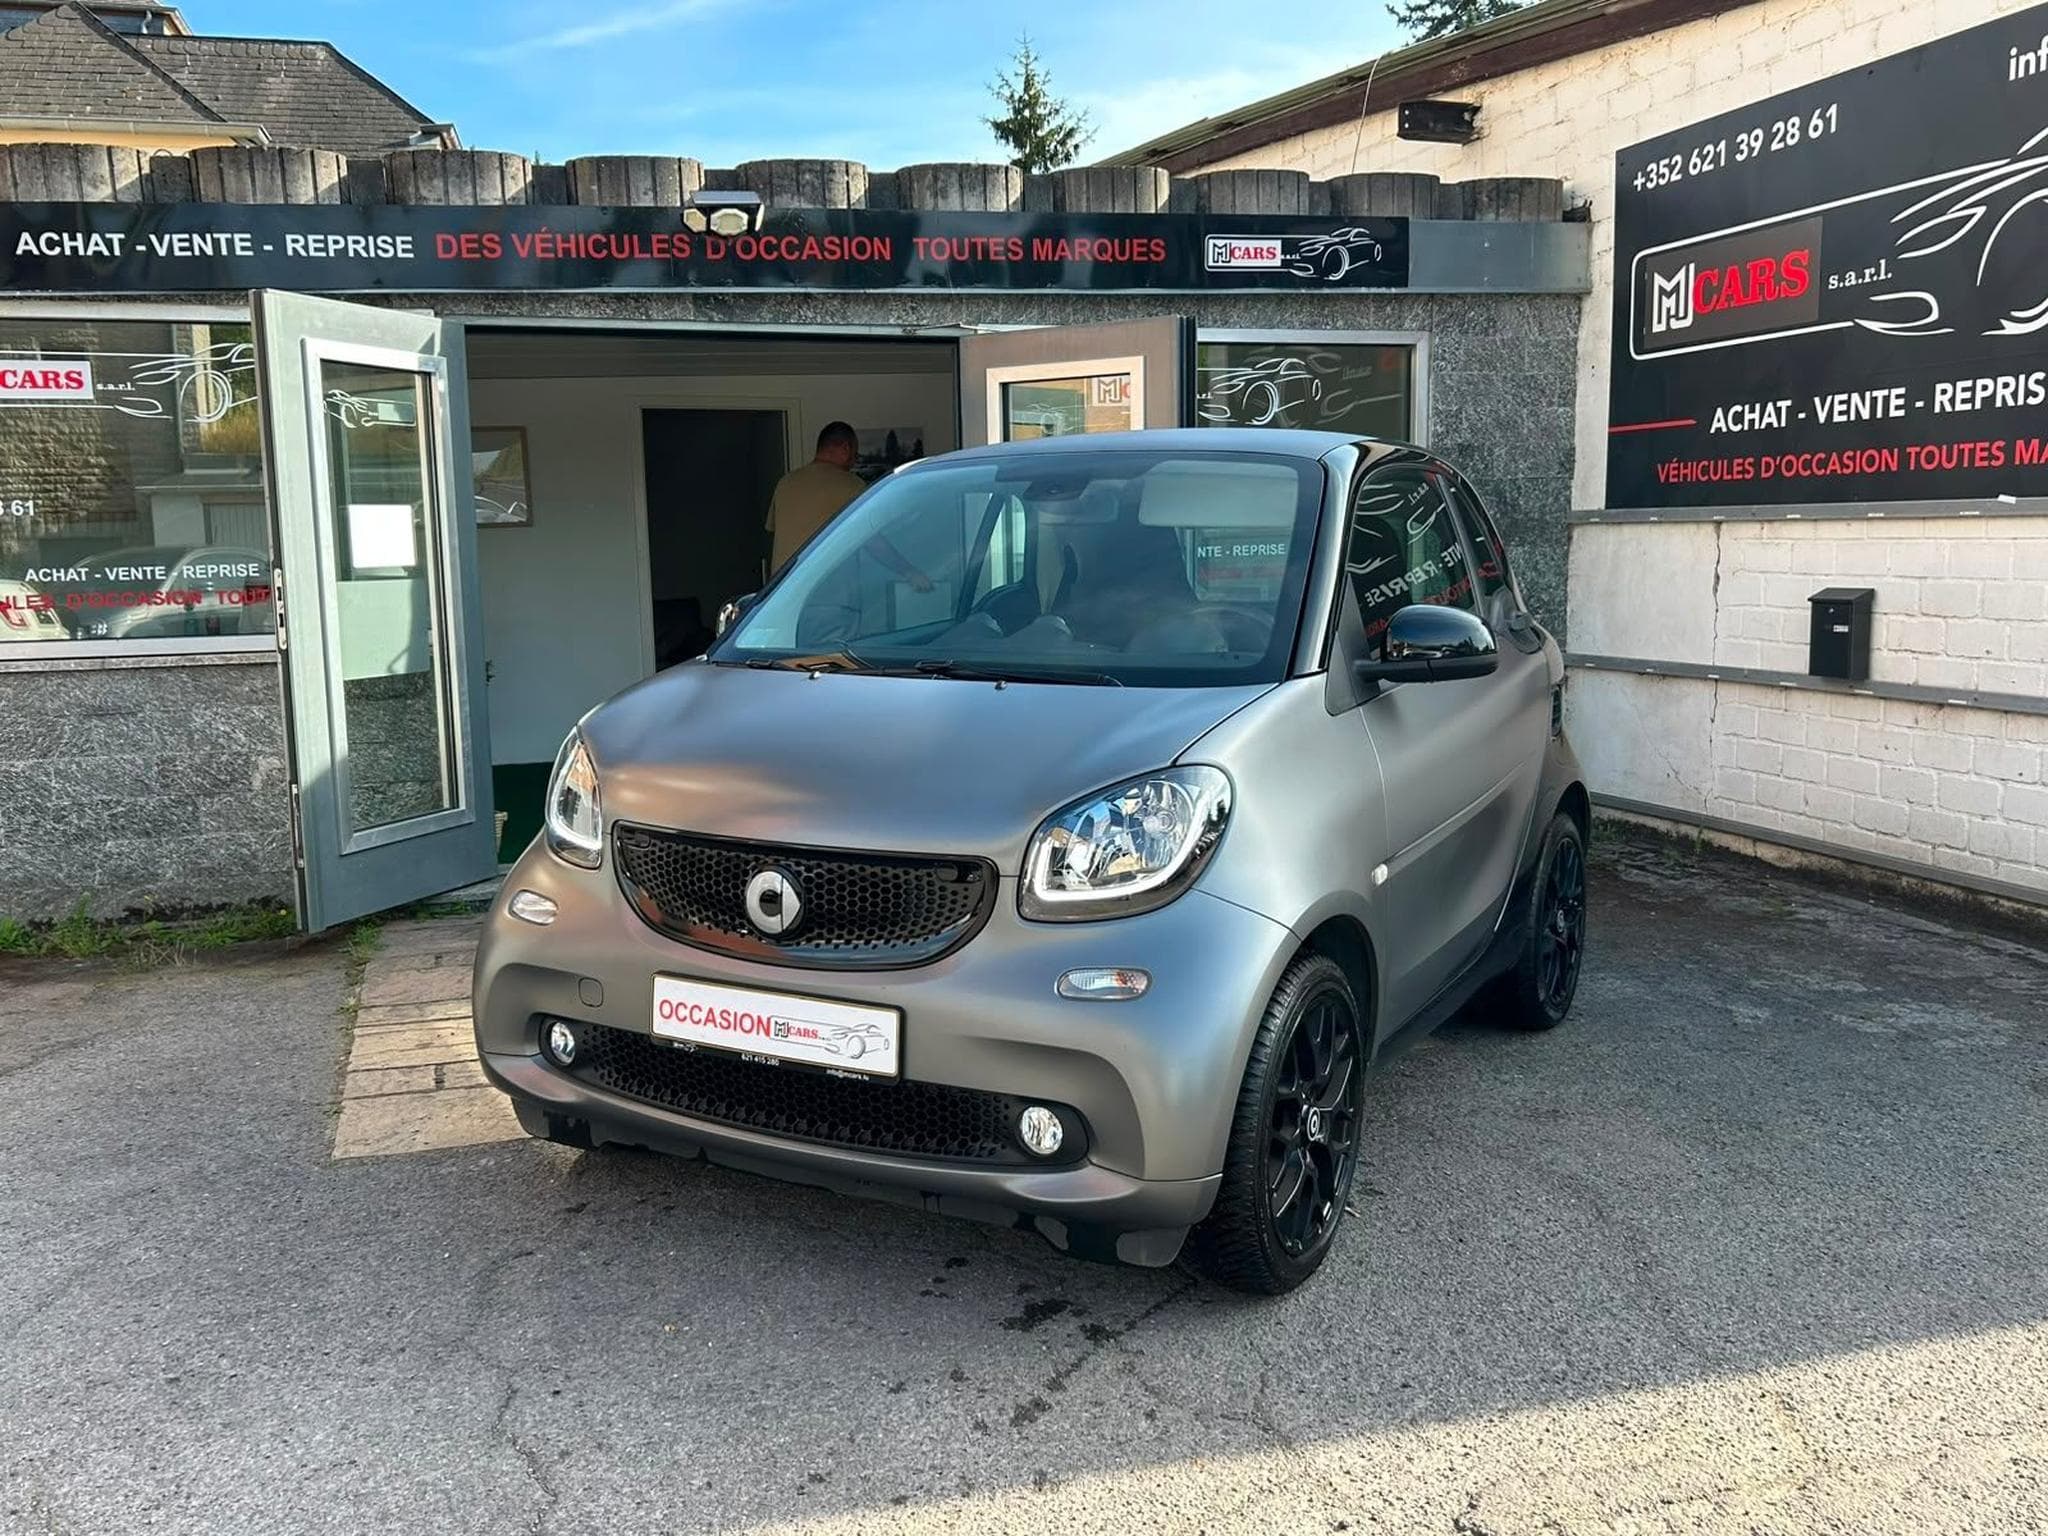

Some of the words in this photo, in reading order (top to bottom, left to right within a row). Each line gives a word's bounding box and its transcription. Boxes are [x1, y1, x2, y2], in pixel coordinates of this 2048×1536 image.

[1633, 154, 1682, 192] +352
[1688, 140, 1726, 177] 621
[1735, 128, 1764, 162] 39
[1771, 116, 1801, 152] 28
[1808, 103, 1838, 139] 61
[15, 232, 125, 256] ACHAT
[285, 235, 414, 259] REPRISE
[435, 233, 502, 260] DES
[511, 225, 691, 260] VÉHICULES
[705, 234, 891, 261] D'OCCASION
[913, 237, 1024, 261] TOUTES
[1032, 238, 1166, 263] MARQUES
[1828, 259, 1892, 290] s.a.r.l.
[0, 369, 84, 390] CARS
[1710, 400, 1792, 434] ACHAT
[1813, 387, 1906, 424] VENTE
[1934, 371, 2047, 414] REPRIS
[1656, 456, 1754, 484] VÉHICULES
[1760, 448, 1899, 480] D'OCCASION
[1906, 439, 2007, 471] TOUTES
[11, 500, 35, 516] 61
[1233, 544, 1286, 557] REPRISE
[25, 568, 89, 582] ACHAT
[105, 566, 166, 581] VENTE
[183, 563, 260, 579] REPRISE
[659, 999, 771, 1038] OCCASION
